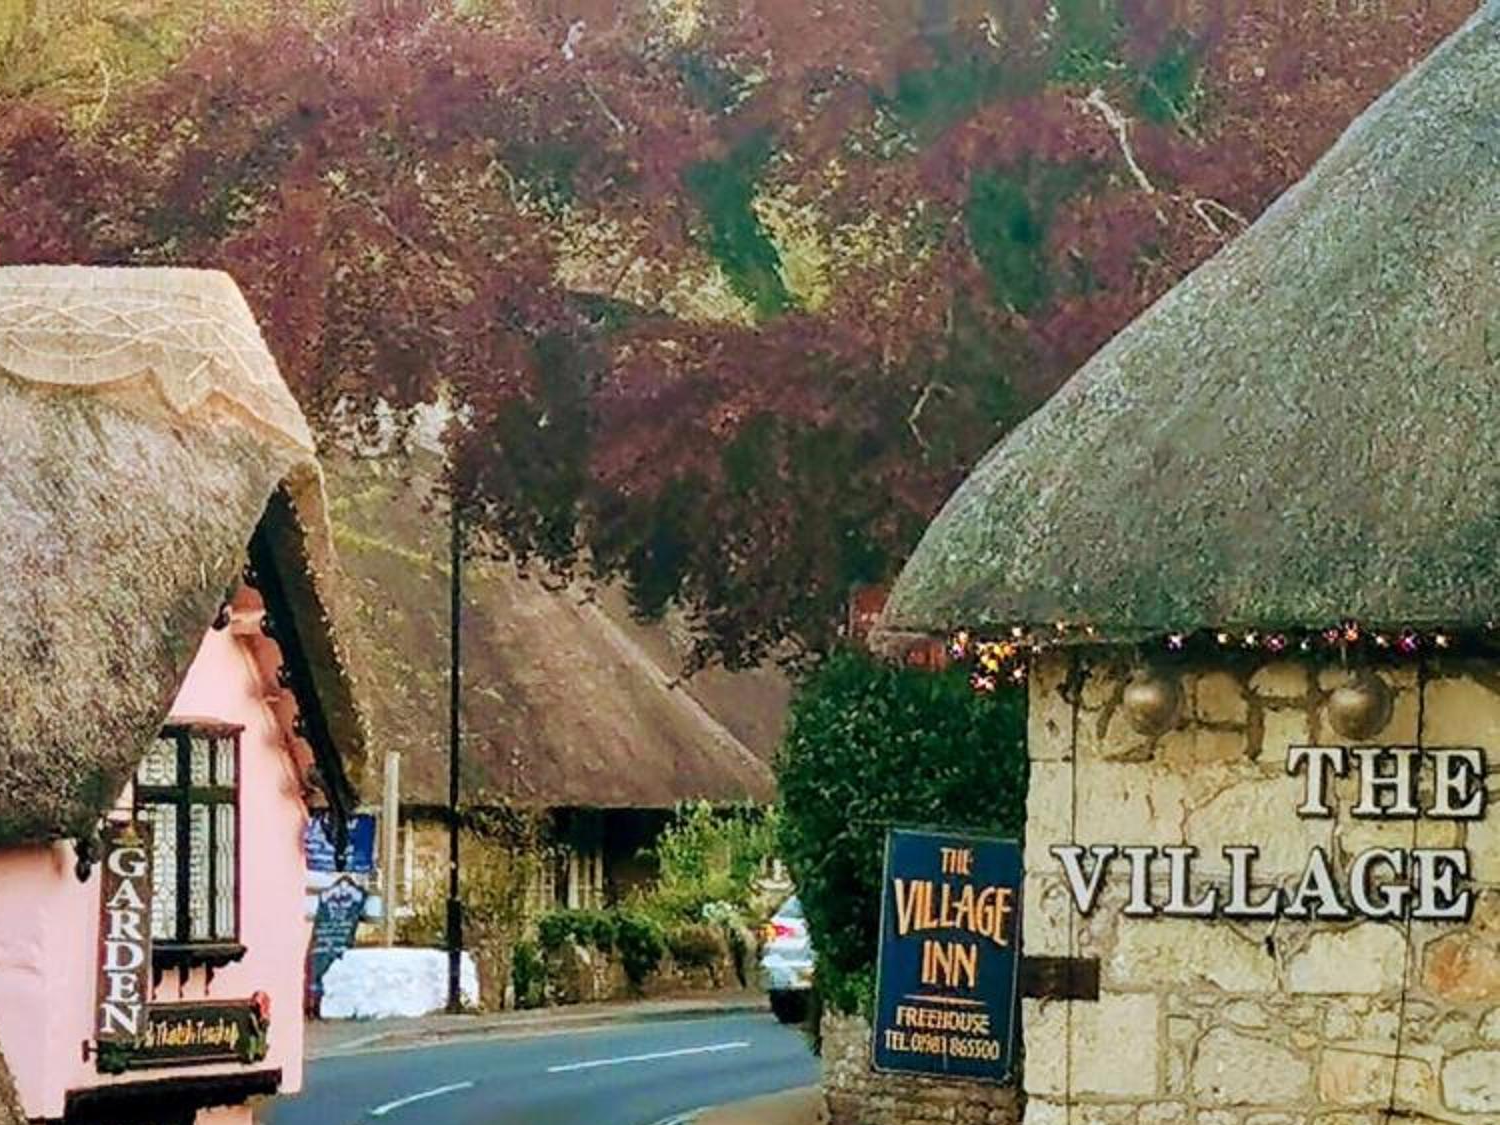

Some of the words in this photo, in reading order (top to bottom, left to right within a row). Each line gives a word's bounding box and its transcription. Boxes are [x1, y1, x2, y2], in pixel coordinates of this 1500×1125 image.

[1287, 746, 1486, 819] THE
[940, 847, 974, 875] THE
[1050, 845, 1473, 920] VILLAGE
[100, 847, 147, 1034] GARDEN
[894, 877, 1013, 946] VILLAGE
[921, 939, 978, 988] INN
[896, 1005, 991, 1035] FREEHOUSE
